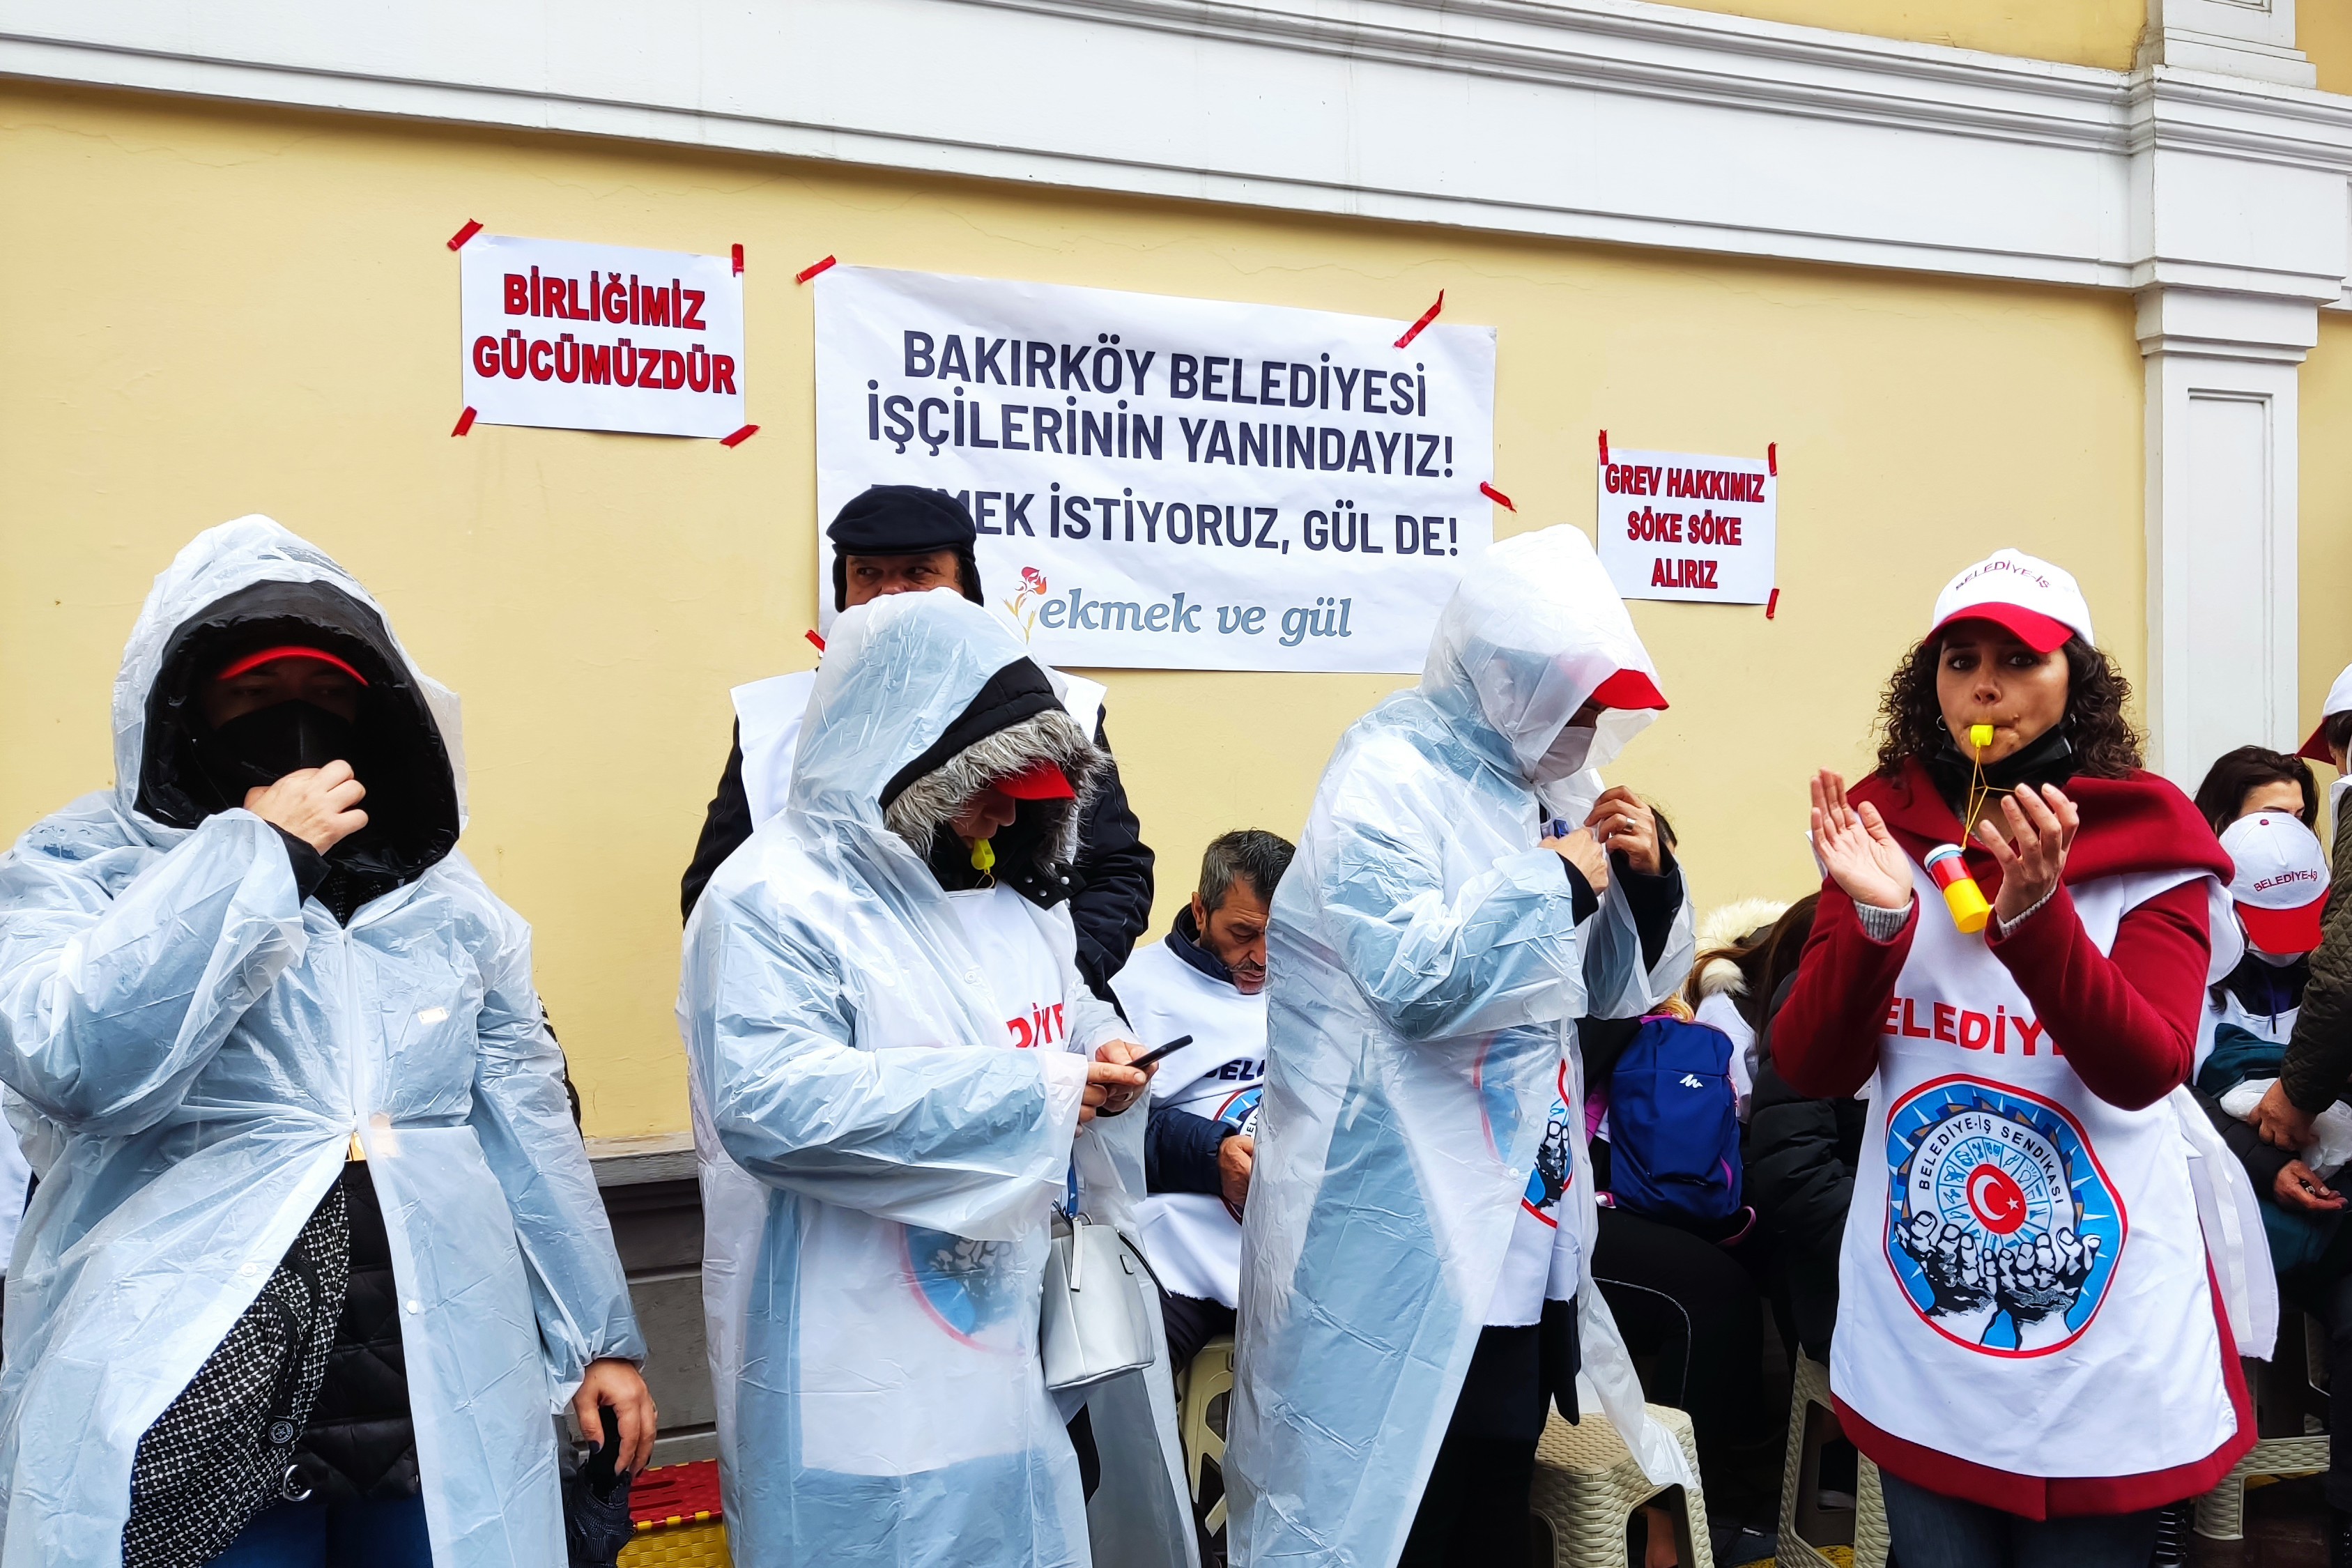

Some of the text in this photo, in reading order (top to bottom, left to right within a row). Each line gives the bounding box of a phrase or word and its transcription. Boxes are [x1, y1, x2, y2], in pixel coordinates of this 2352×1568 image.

[504, 265, 707, 331] BİRLİĞİMİZ
[472, 328, 737, 395] GÜCÜMÜZDÜR
[904, 330, 1426, 417] BAKIRKÖY BELEDİYESİ
[867, 379, 1453, 478] İŞÇİLERİNİN YANINDAYIZ!
[1605, 463, 1765, 503] GREV HAKKIMIZ
[1050, 482, 1289, 555] İSTİYORUZ,
[1303, 499, 1383, 554] GÜL
[1395, 514, 1458, 557] DE!
[1627, 505, 1742, 546] SÖKE SÖKE
[1650, 558, 1719, 590] ALIRIZ
[1038, 587, 1352, 647] ekmek ve gül
[1882, 998, 2063, 1056] ELEDİY
